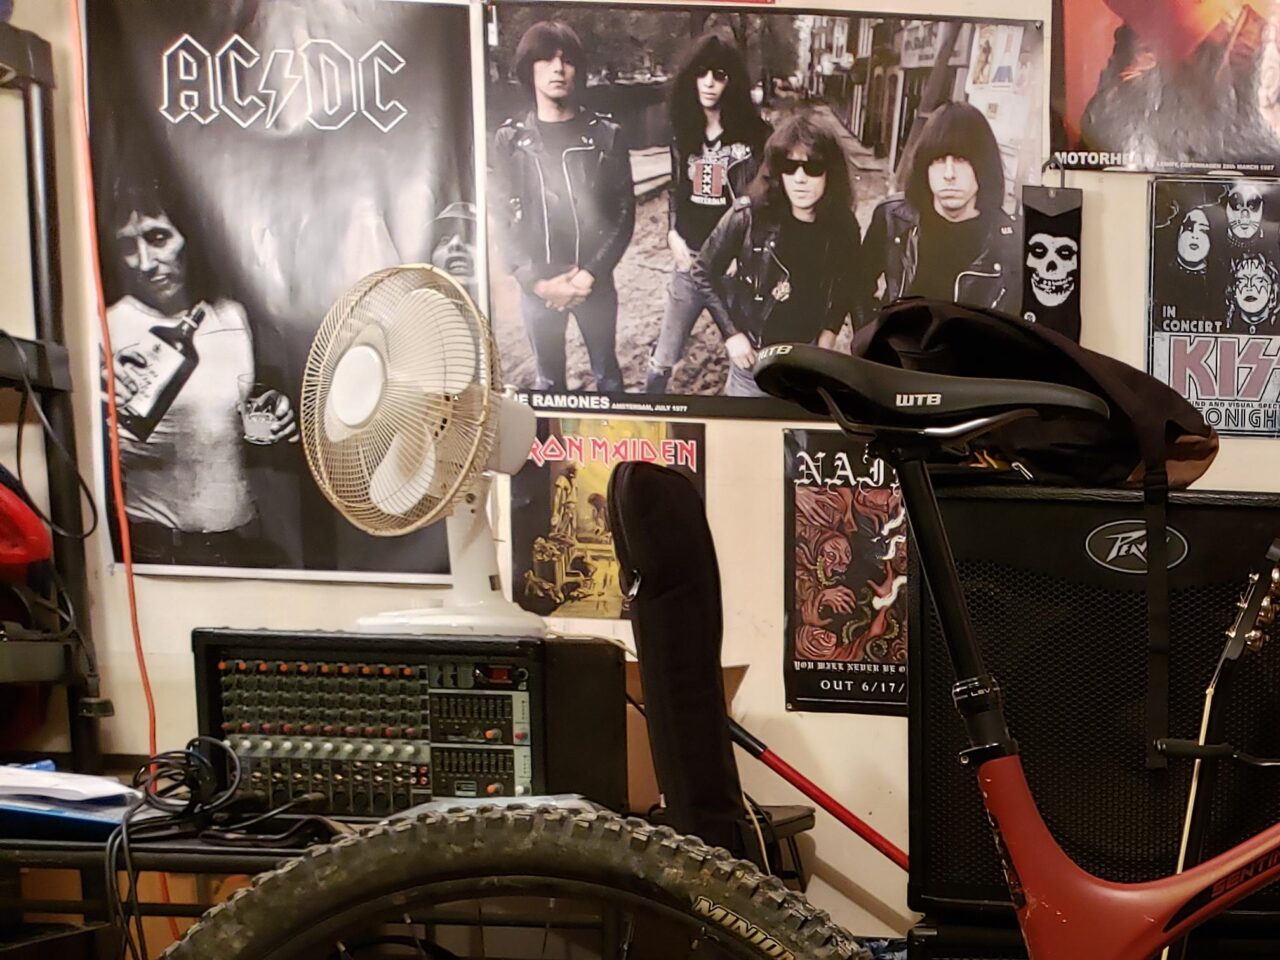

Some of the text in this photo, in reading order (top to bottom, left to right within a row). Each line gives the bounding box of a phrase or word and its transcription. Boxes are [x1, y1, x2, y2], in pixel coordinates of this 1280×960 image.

[1162, 305, 1176, 318] IN
[1163, 320, 1223, 333] CONCERT
[533, 394, 610, 409] RAMONES
[896, 394, 942, 406] WTB
[528, 433, 699, 473] RON MAIDEN
[820, 680, 854, 691] OUT
